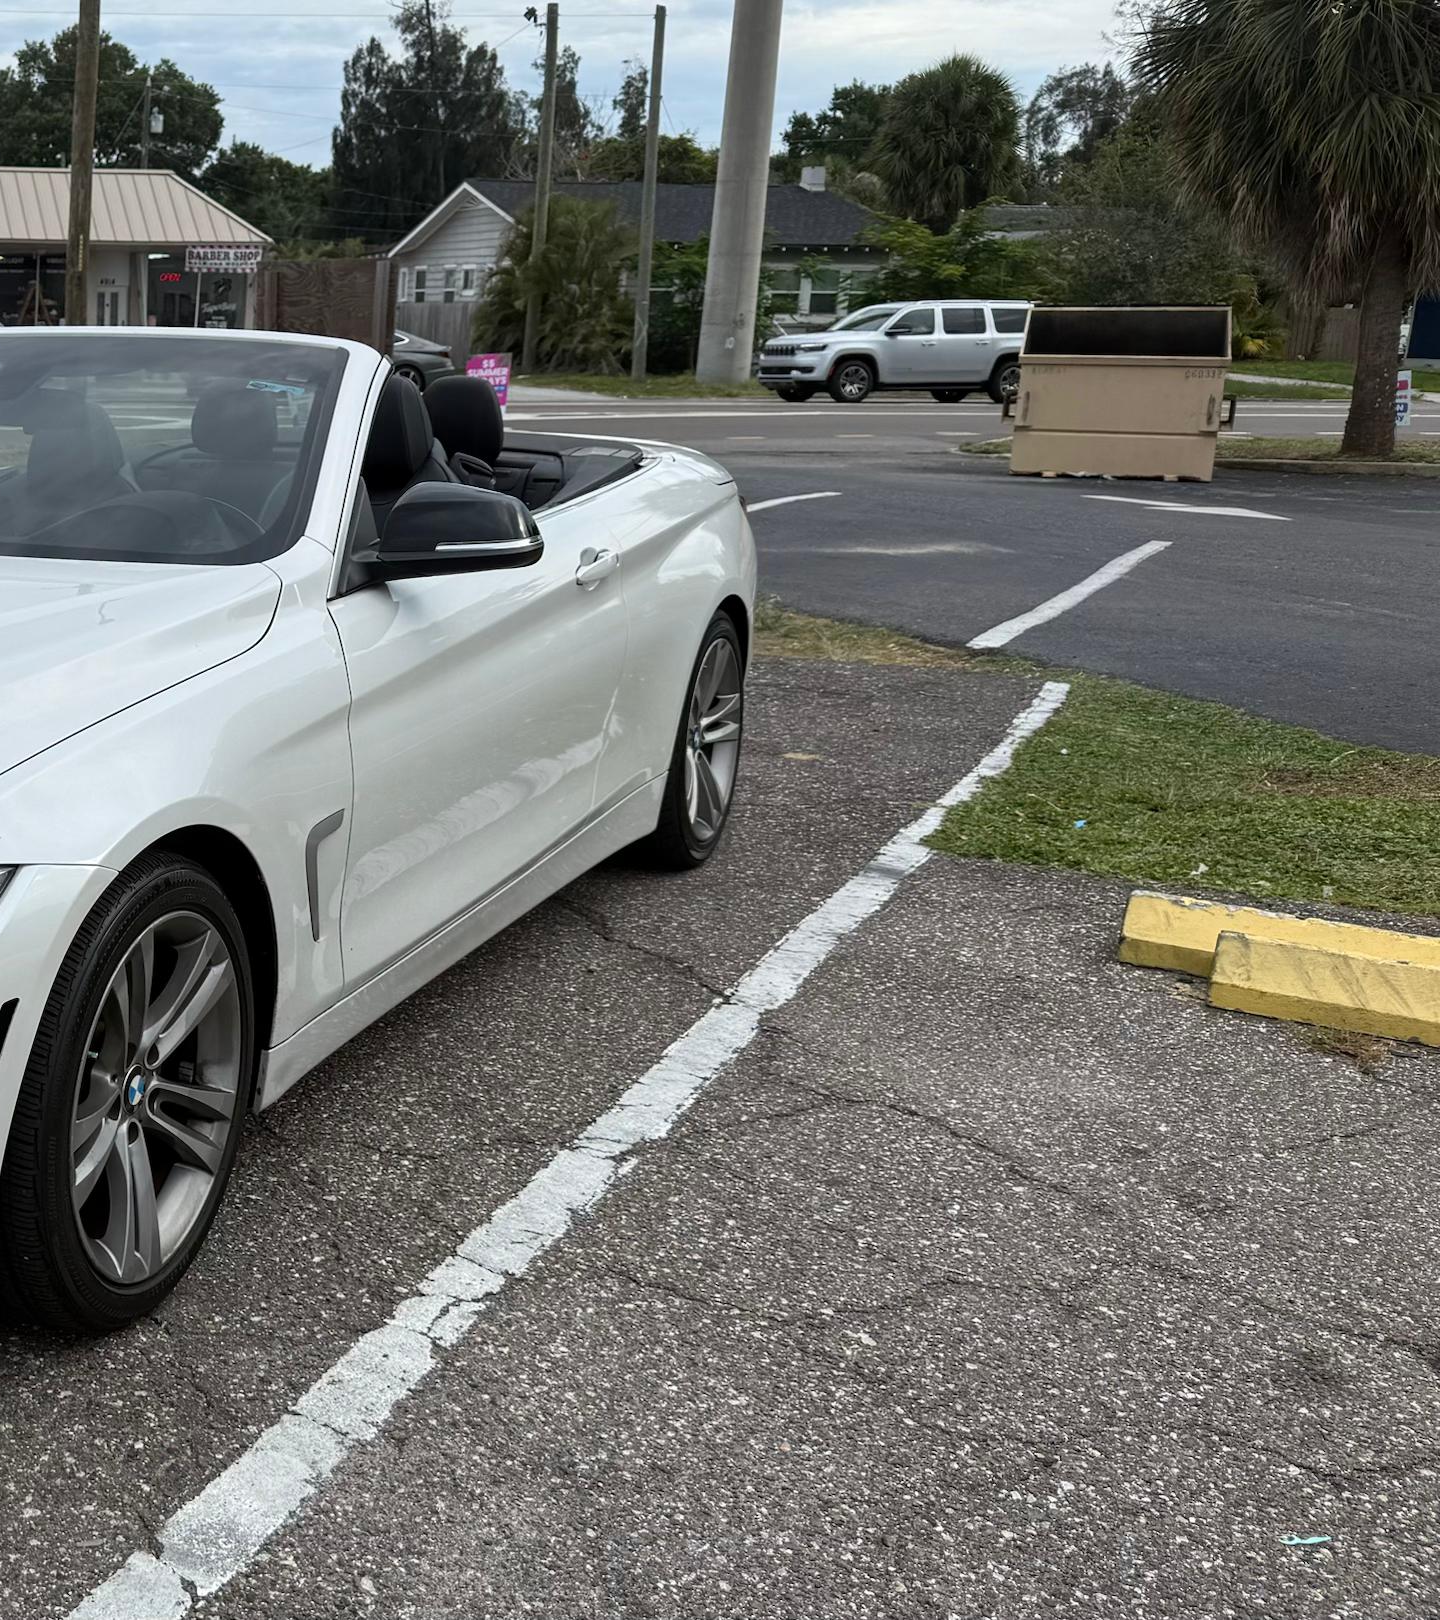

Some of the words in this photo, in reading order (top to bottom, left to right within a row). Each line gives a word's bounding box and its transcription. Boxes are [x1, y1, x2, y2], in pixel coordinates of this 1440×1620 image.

[188, 249, 231, 261] BARBER
[233, 250, 260, 262] SHOP
[160, 272, 182, 282] OPEN
[467, 367, 508, 377] SUMMER
